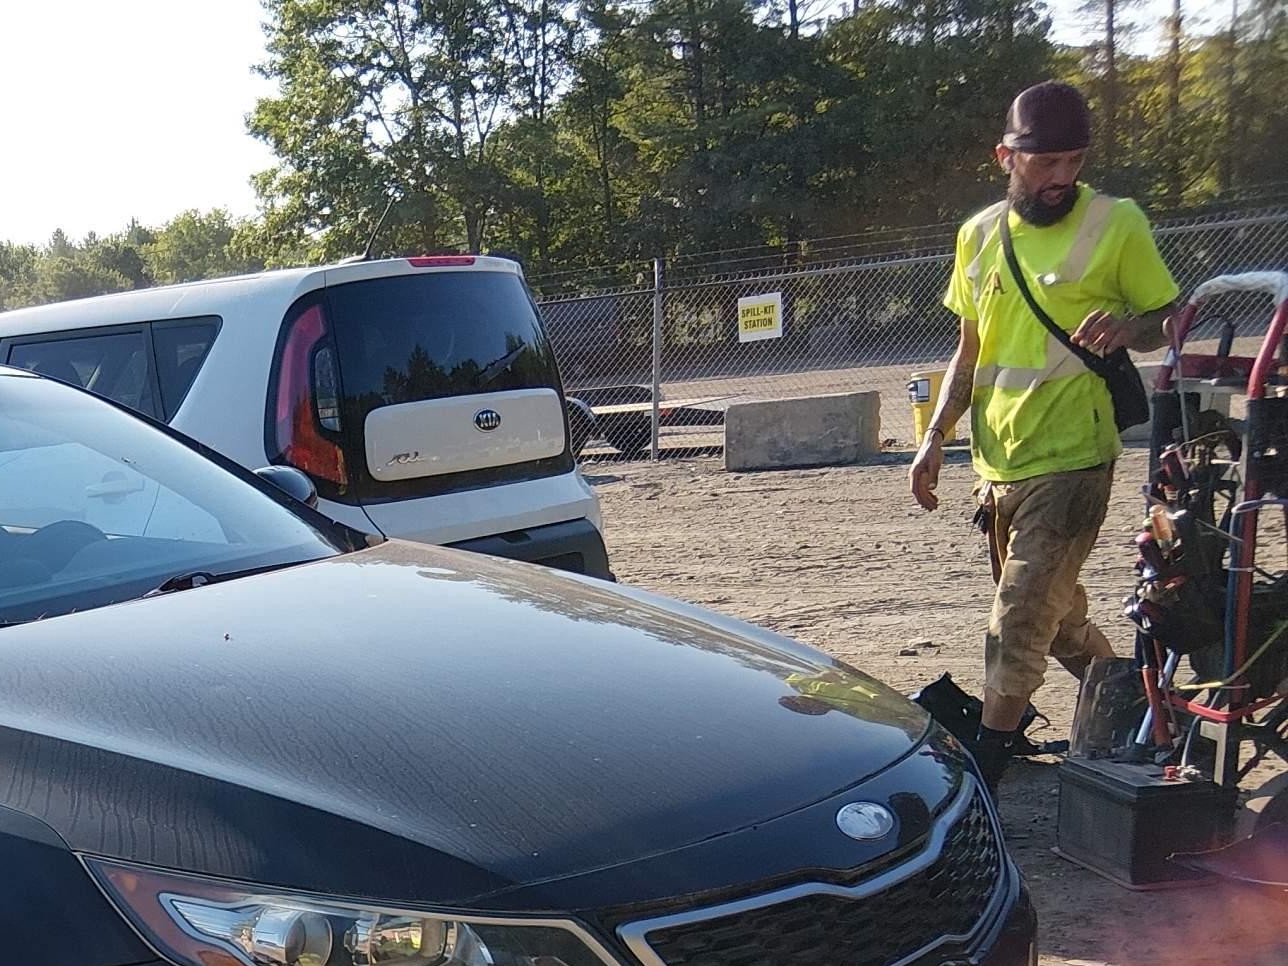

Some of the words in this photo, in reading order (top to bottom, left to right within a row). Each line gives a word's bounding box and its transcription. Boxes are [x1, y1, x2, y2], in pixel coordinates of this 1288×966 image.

[741, 304, 775, 318] SPILL-KIT
[744, 318, 773, 330] STATION
[478, 412, 500, 428] KIA
